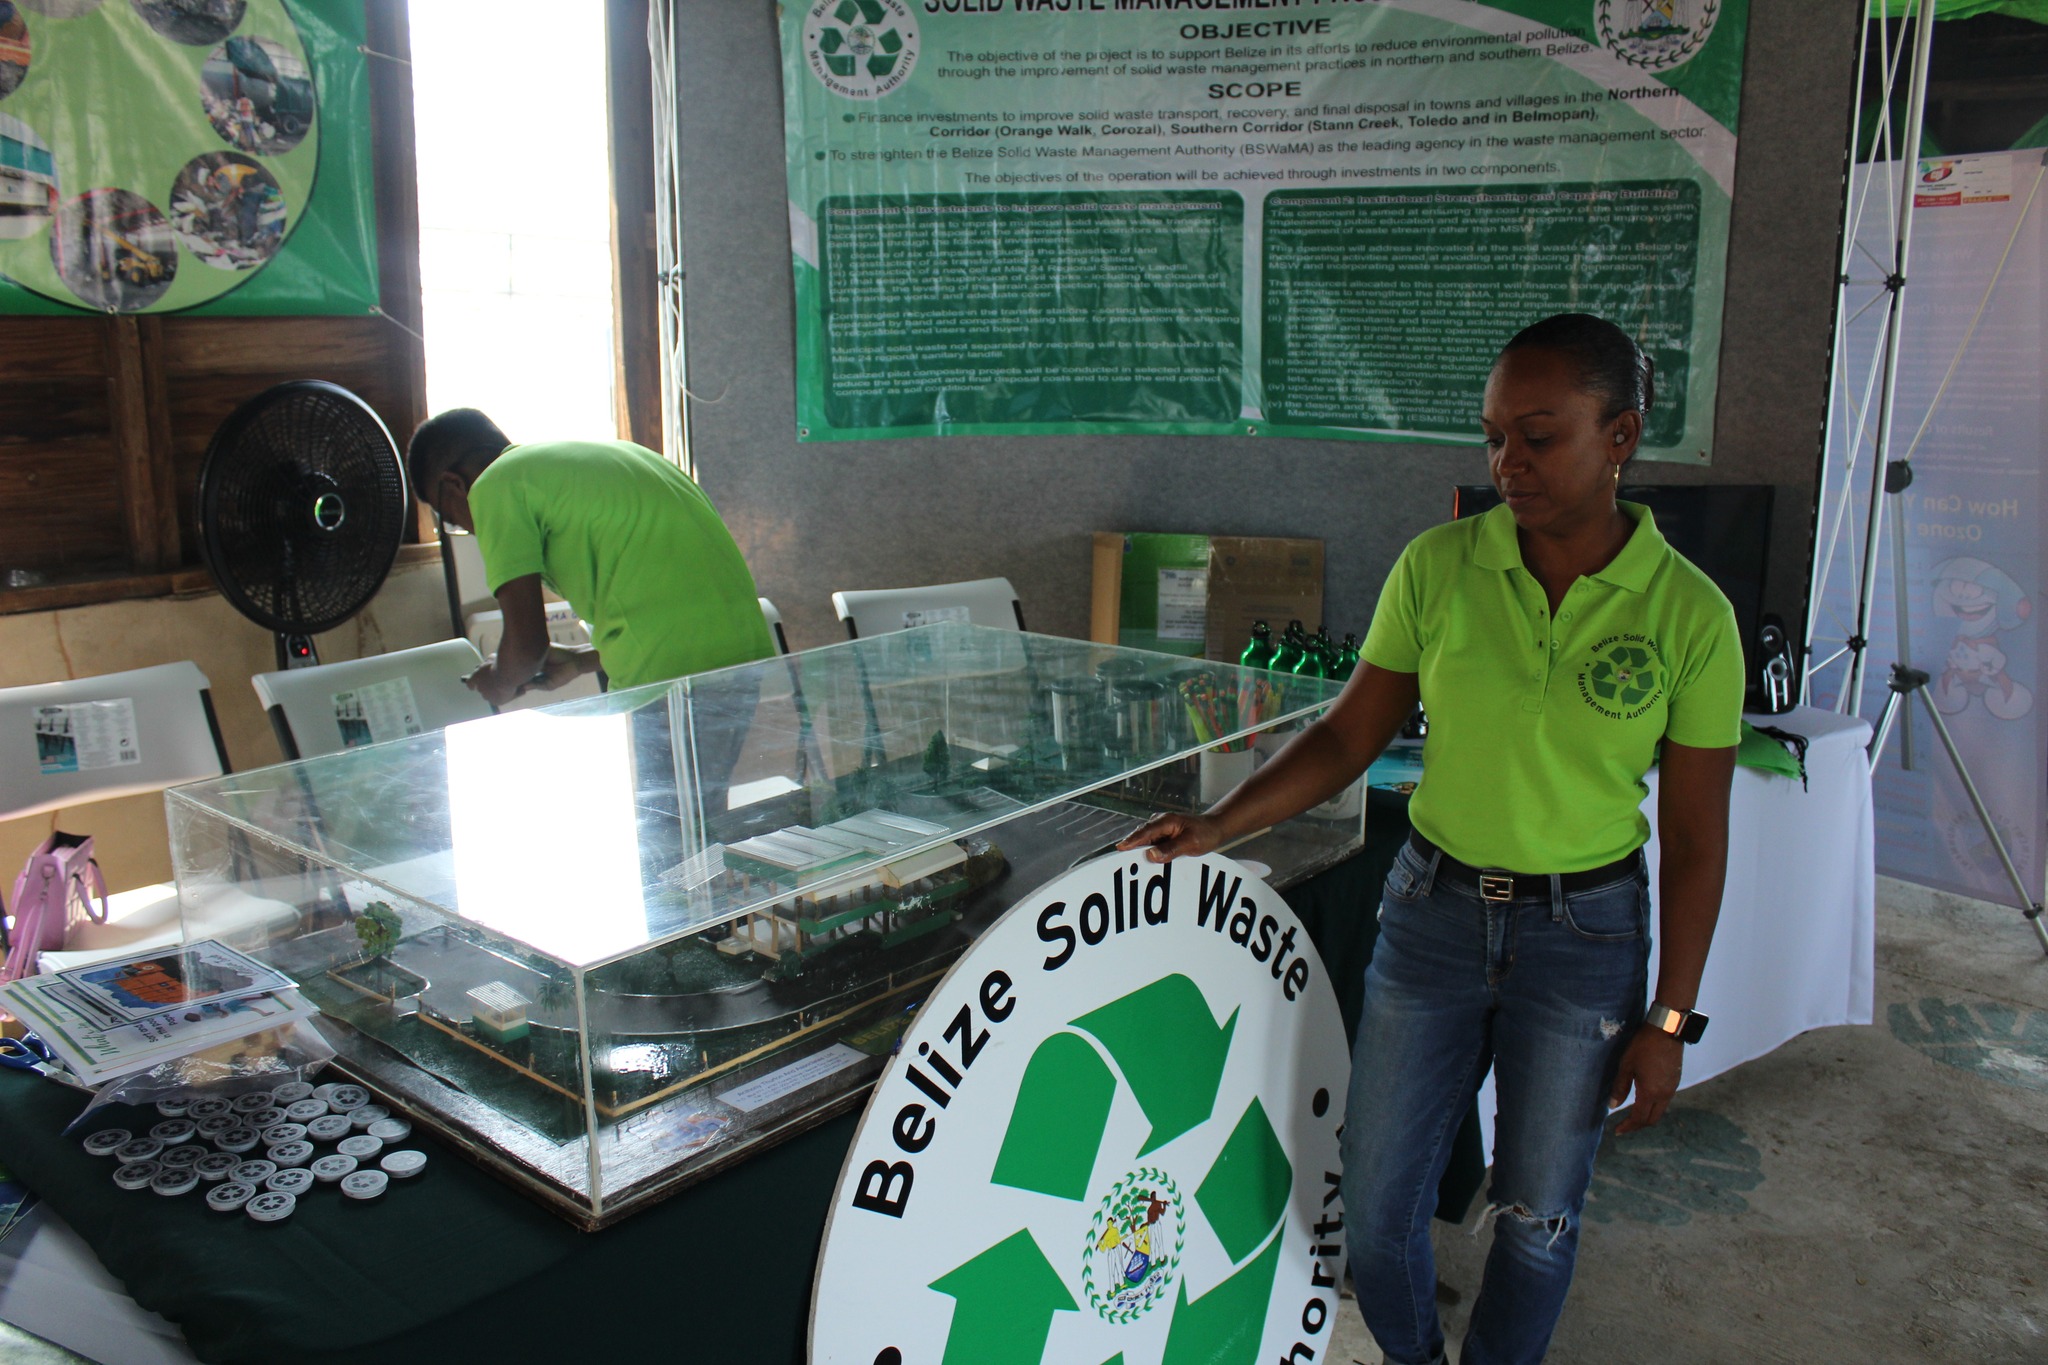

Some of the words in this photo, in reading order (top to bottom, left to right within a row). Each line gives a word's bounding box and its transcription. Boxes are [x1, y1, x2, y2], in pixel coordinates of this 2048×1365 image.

[1114, 0, 1301, 11] MANAGE
[947, 50, 974, 63] The
[977, 49, 1039, 64] objective
[1043, 48, 1055, 61] of
[1137, 48, 1147, 60] is
[1152, 49, 1165, 60] to
[1169, 47, 1220, 62] support
[1225, 45, 1267, 58] Belize
[1271, 44, 1282, 56] in
[1286, 43, 1303, 56] its
[1307, 43, 1350, 56] efforts
[1355, 42, 1368, 53] to
[1372, 38, 1418, 52] reduce
[1422, 30, 1521, 49] environmental
[1526, 25, 1586, 45] pollution
[1180, 19, 1331, 40] OBJECTIVE
[809, 49, 868, 97] Management
[876, 49, 915, 95] Authority
[938, 65, 990, 80] through
[995, 65, 1016, 77] the
[1020, 64, 1109, 79] improvement
[1113, 63, 1126, 75] of
[1131, 62, 1162, 75] solid
[1167, 64, 1207, 75] waste
[1211, 60, 1300, 75] management
[1305, 57, 1366, 73] practices
[1370, 55, 1382, 68] in
[1386, 52, 1444, 67] northern
[1449, 49, 1474, 63] and
[1479, 47, 1541, 61] southern
[1546, 43, 1593, 57] Belize.
[917, 110, 998, 122] investments
[1002, 110, 1015, 121] to
[1019, 108, 1074, 123] improve
[1078, 108, 1109, 121] solid
[1113, 109, 1154, 120] waste
[1294, 104, 1319, 117] and
[1323, 103, 1350, 116] final
[1354, 99, 1410, 117] disposal
[1414, 99, 1425, 112] in
[1430, 99, 1471, 111] towns
[1475, 95, 1501, 109] and
[1506, 94, 1560, 108] villages
[1564, 91, 1576, 104] in
[1581, 89, 1603, 103] the
[1608, 86, 1679, 100] Northern
[1208, 81, 1302, 99] SCOPE
[930, 124, 990, 137] Corridor
[995, 124, 1053, 139] (Orange
[1101, 122, 1165, 137] Corozal),
[1170, 121, 1238, 135] Southern
[1243, 120, 1304, 133] Corridor
[1308, 119, 1354, 134] (Stann
[1408, 114, 1458, 128] Toledo
[1462, 112, 1490, 126] and
[1494, 111, 1508, 124] in
[830, 148, 846, 161] To
[927, 147, 947, 159] the
[952, 146, 994, 159] Belize
[997, 146, 1031, 159] Solid
[1036, 145, 1078, 158] Waste
[1082, 145, 1171, 159] Management
[1174, 143, 1235, 158] Authority
[1240, 141, 1314, 158] (BSWaMA)
[1318, 143, 1334, 153] as
[1337, 140, 1359, 153] the
[1362, 138, 1411, 153] leading
[1415, 139, 1466, 152] agency
[1469, 136, 1482, 148] in
[1486, 135, 1509, 148] the
[1513, 134, 1555, 147] waste
[1559, 129, 1656, 145] management
[965, 171, 990, 183] The
[995, 170, 1061, 186] objectives
[1066, 170, 1080, 183] of
[1083, 170, 1104, 182] the
[1108, 169, 1172, 185] operation
[1175, 168, 1197, 181] will
[1202, 168, 1219, 181] be
[1223, 167, 1284, 180] achieved
[1288, 166, 1336, 181] through
[1341, 165, 1421, 178] investments
[1425, 164, 1438, 176] in
[1442, 165, 1466, 176] two
[1471, 162, 1560, 177] components.
[1065, 203, 1097, 211] solid
[1139, 201, 1222, 211] management
[1529, 192, 1555, 201] and
[1591, 635, 1620, 653] Belize
[1623, 633, 1646, 643] Solid
[1577, 672, 1621, 720] Management
[1626, 688, 1663, 720] Authority
[852, 969, 1017, 1220] Belize
[1036, 862, 1172, 972] Solid
[1197, 864, 1310, 1002] Waste
[1280, 1171, 1344, 1365] hority
